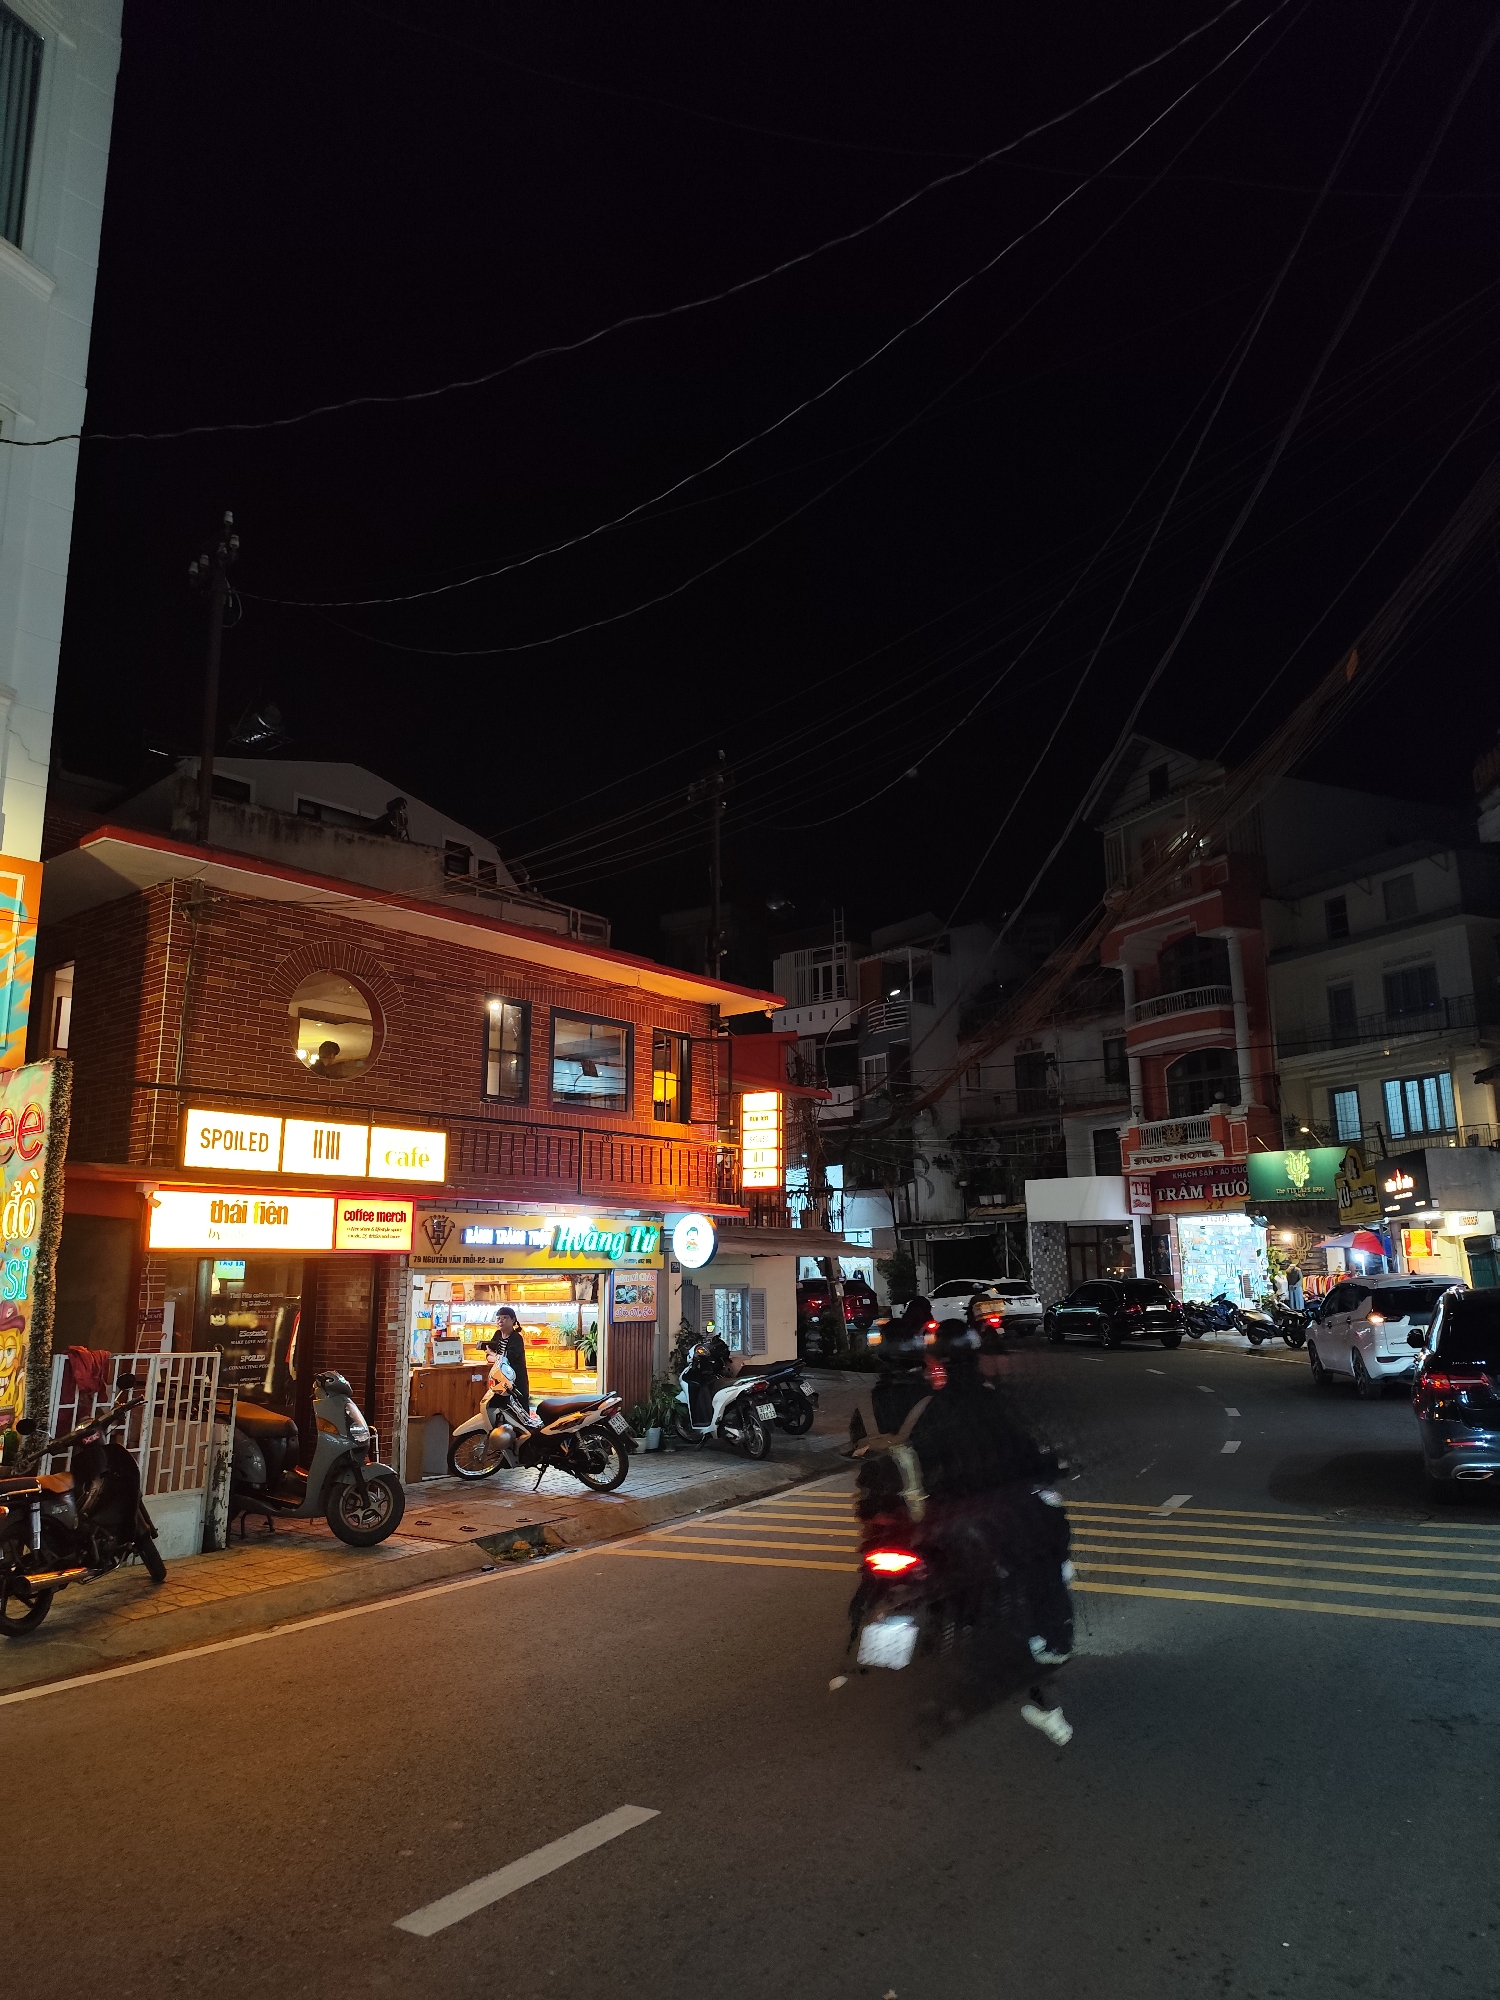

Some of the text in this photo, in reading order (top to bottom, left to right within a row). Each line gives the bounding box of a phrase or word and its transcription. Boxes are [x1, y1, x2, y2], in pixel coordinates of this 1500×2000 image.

[200, 1127, 269, 1152] SPOILED
[385, 1146, 430, 1168] café
[1134, 1149, 1218, 1165] STUDIO HOTEL
[1172, 1168, 1198, 1180] KHÁCH
[1199, 1166, 1214, 1179] SẠN
[1132, 1181, 1150, 1196] TH
[1155, 1179, 1250, 1201] TRẦM HƯƠ
[210, 1199, 249, 1224] thái
[344, 1208, 407, 1223] coffee merch
[413, 1255, 422, 1263] 79
